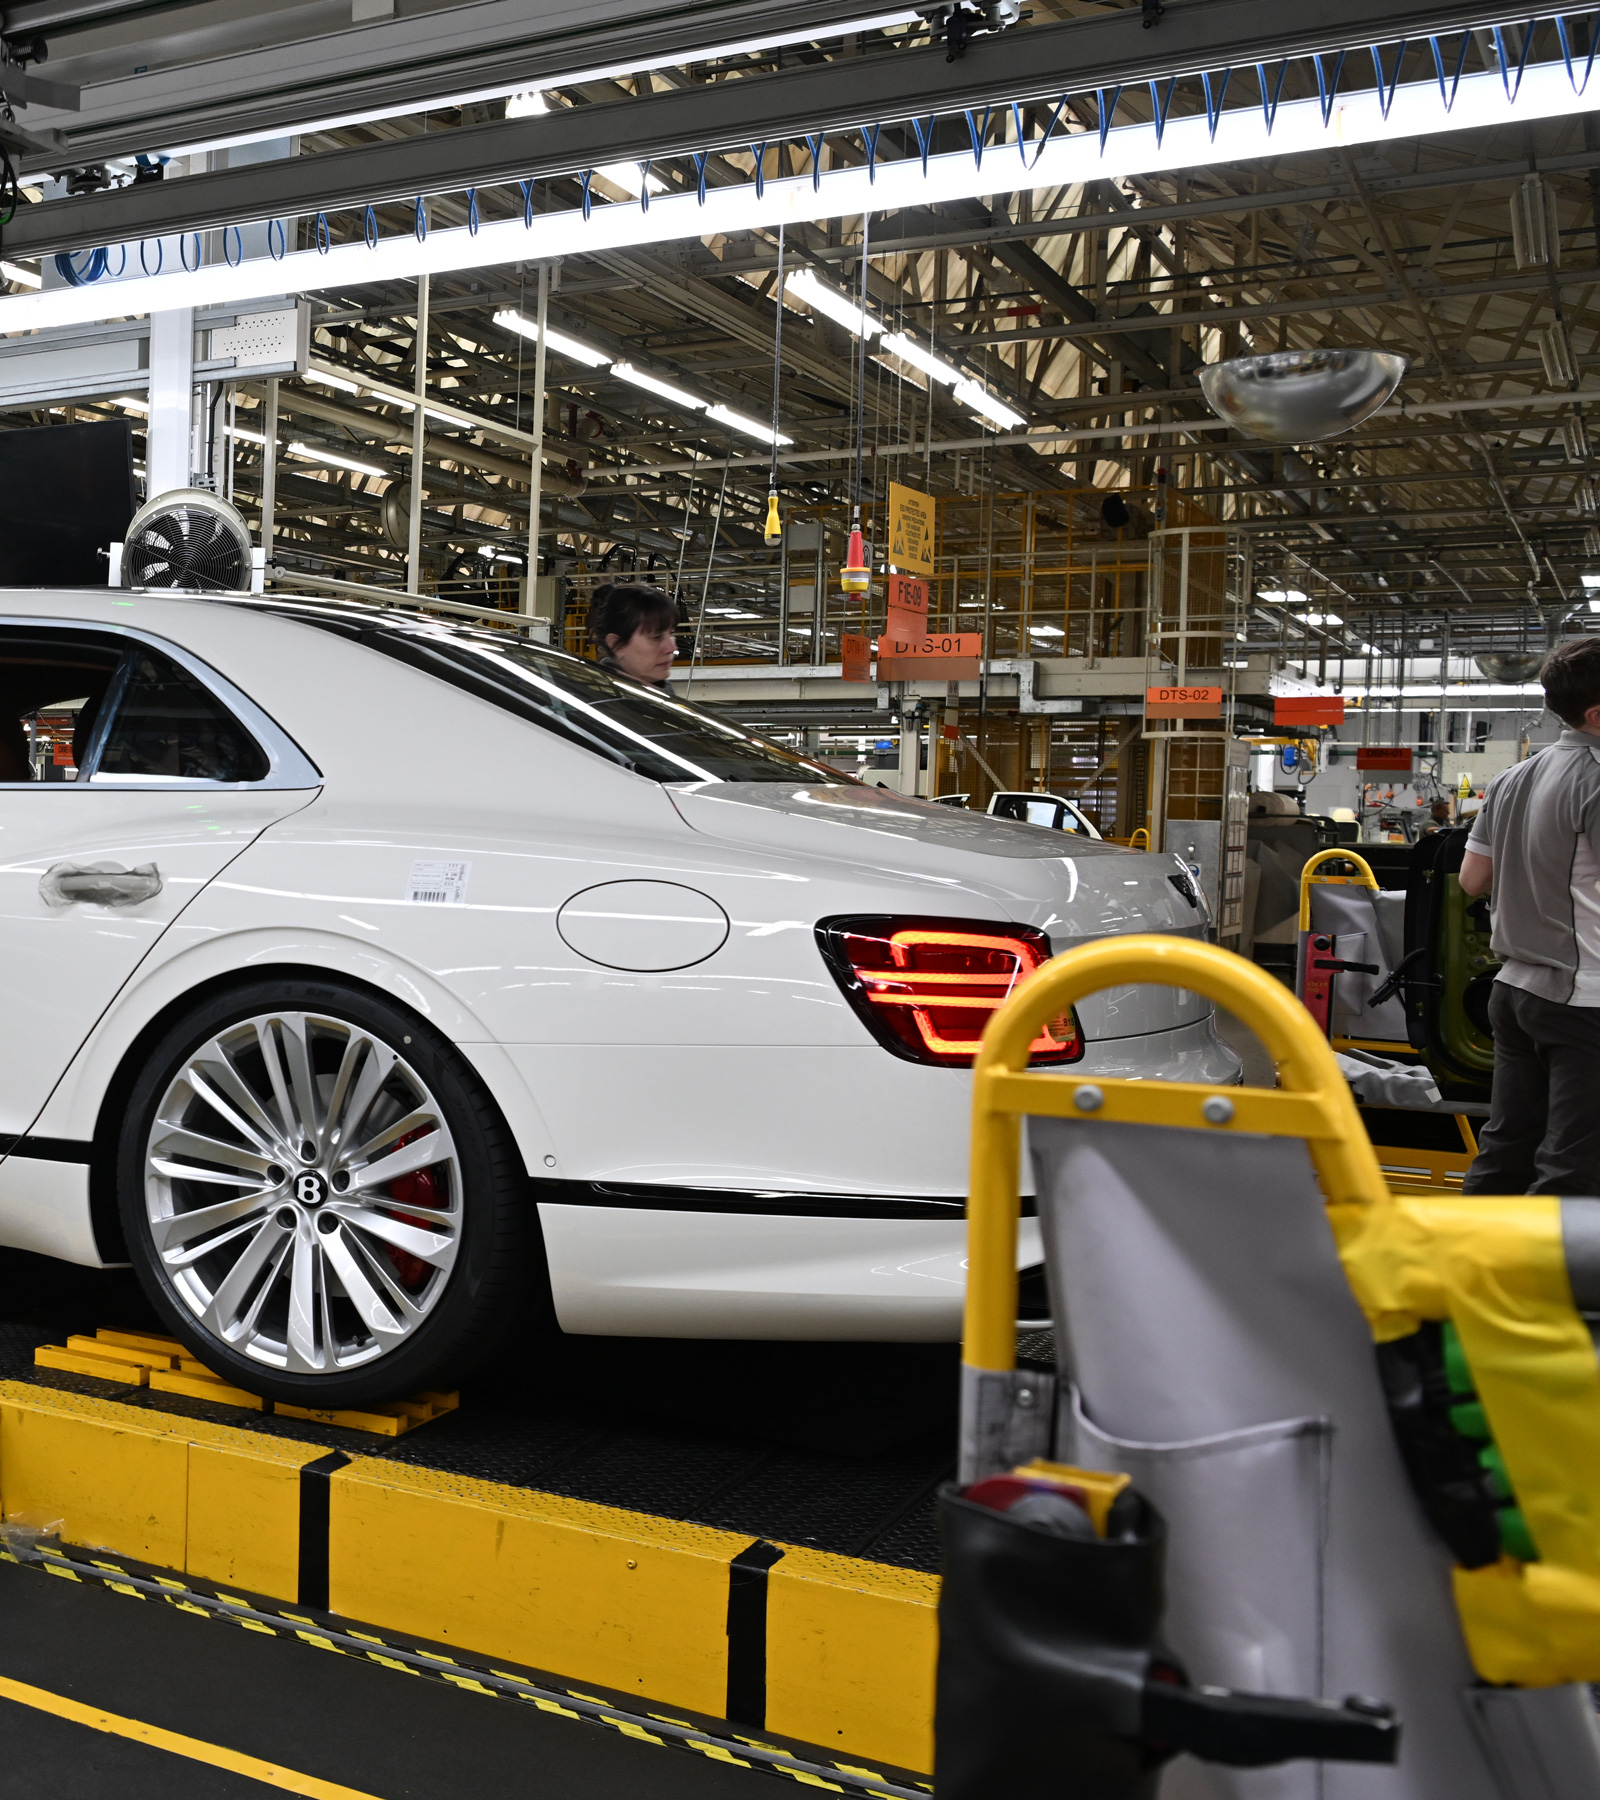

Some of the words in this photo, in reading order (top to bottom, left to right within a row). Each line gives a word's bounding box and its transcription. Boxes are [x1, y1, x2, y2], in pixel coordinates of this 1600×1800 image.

[898, 581, 922, 607] F1E-09
[1159, 689, 1209, 701] DTS-02
[297, 1175, 321, 1204] B
